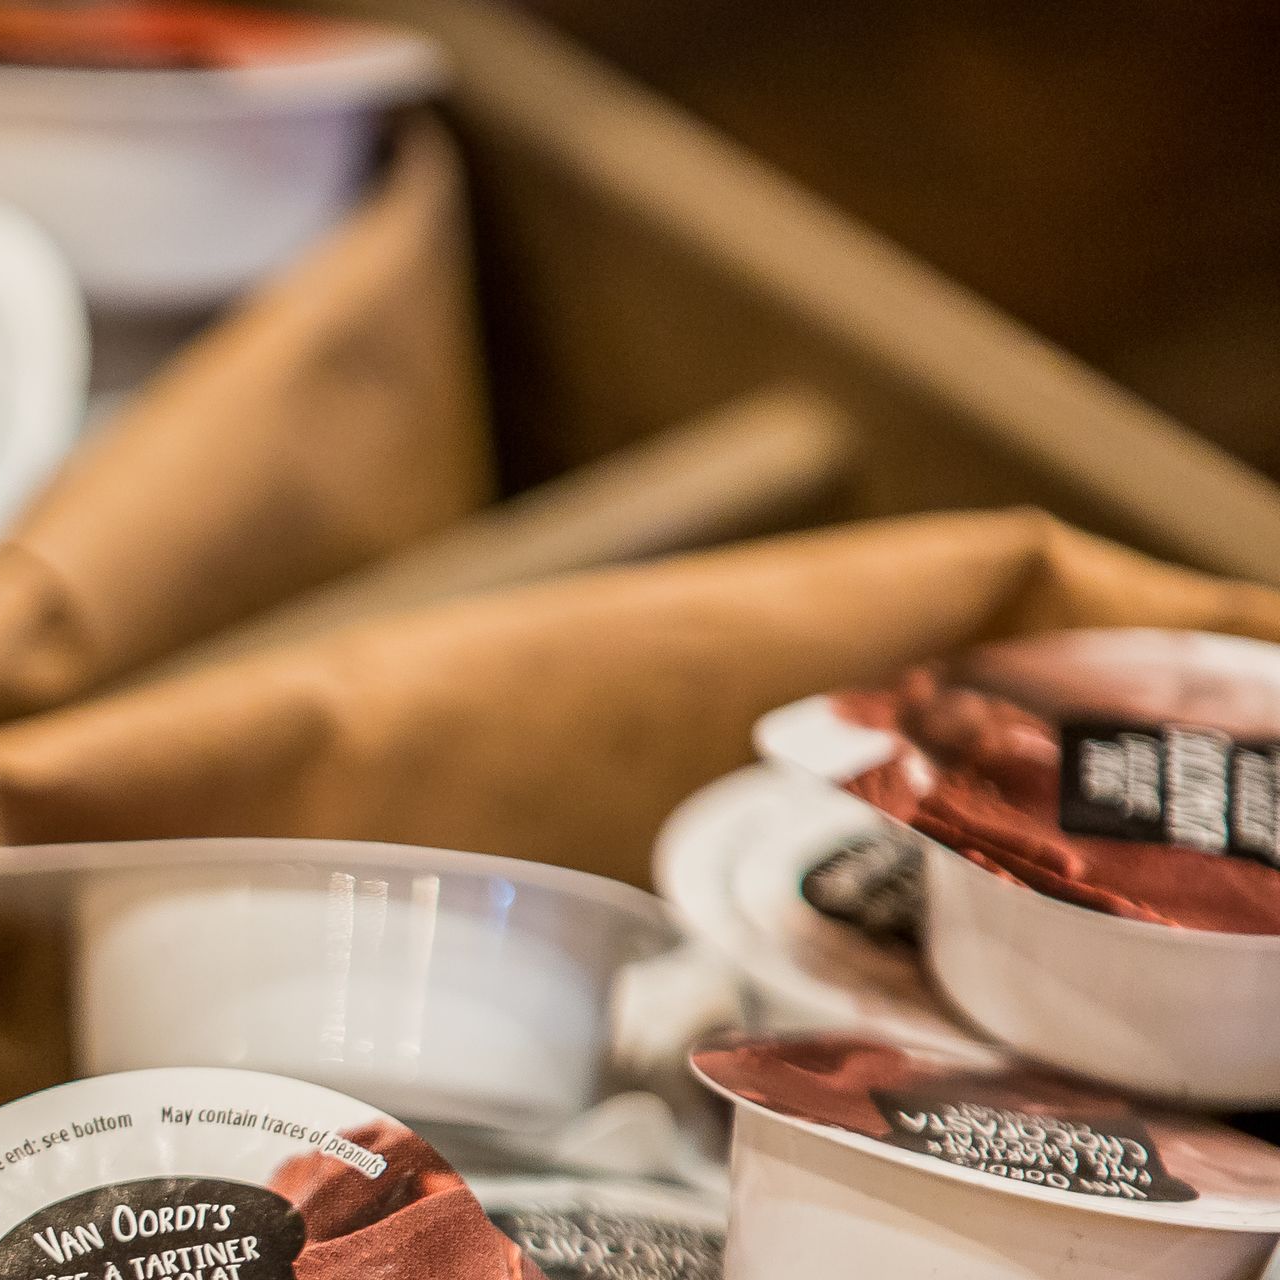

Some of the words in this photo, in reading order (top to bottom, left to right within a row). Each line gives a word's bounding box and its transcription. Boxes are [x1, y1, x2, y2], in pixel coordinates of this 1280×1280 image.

[5, 1139, 41, 1164] end:
[42, 1127, 70, 1149] see
[72, 1113, 133, 1138] bottom
[161, 1106, 193, 1126] May
[198, 1107, 258, 1128] contain
[261, 1113, 308, 1140] traces
[309, 1129, 330, 1146] of
[324, 1136, 387, 1176] peanuts
[33, 1222, 105, 1265] VAN
[130, 1235, 261, 1280] TARTINER
